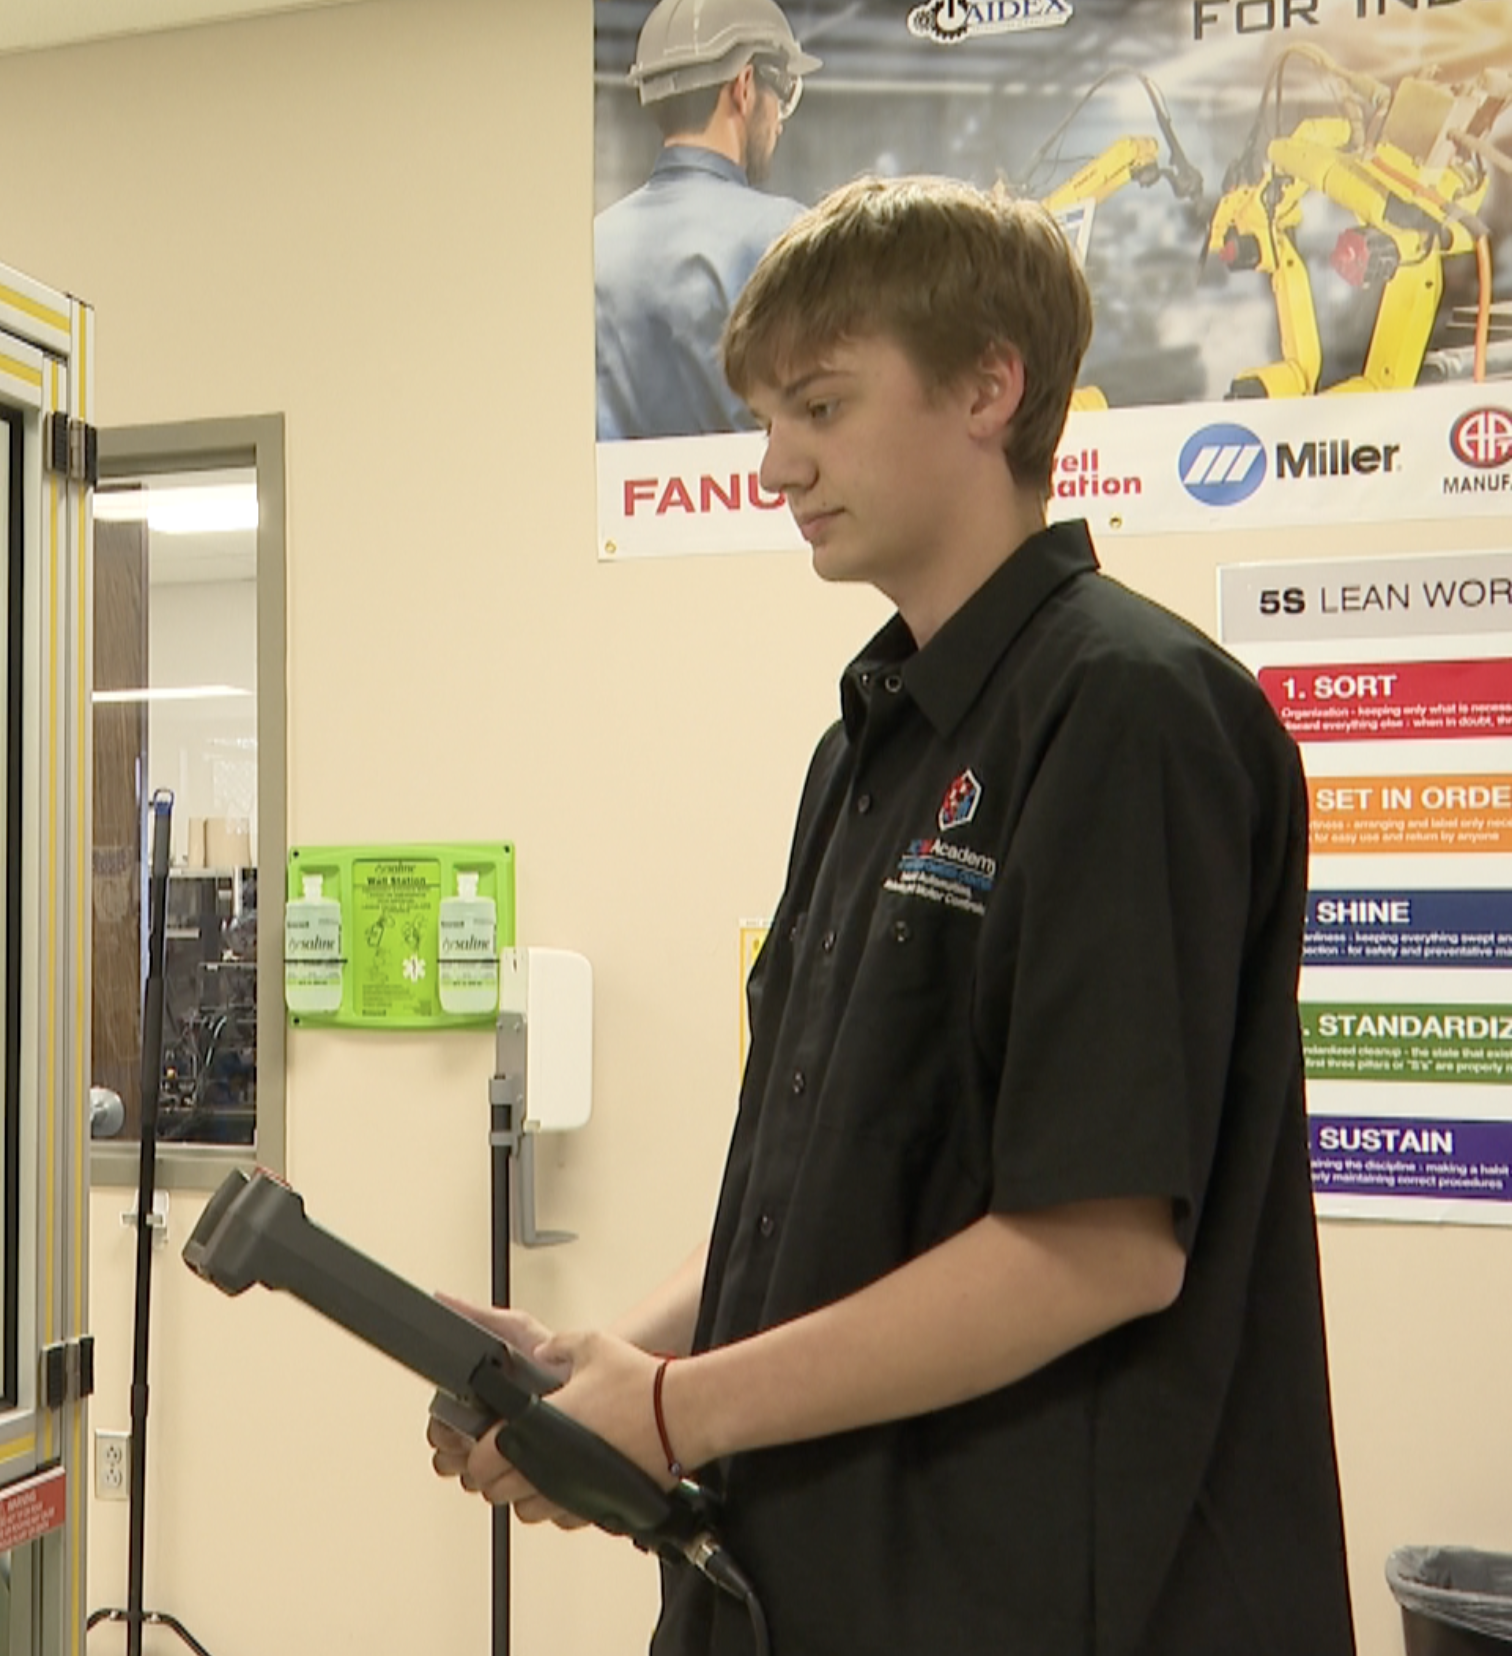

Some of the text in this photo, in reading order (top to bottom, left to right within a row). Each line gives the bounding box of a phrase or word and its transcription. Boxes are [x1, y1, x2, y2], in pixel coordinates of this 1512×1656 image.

[1194, 0, 1319, 40] FOR
[1053, 448, 1099, 473] ell
[1276, 440, 1401, 479] Miller
[624, 472, 786, 517] FANU
[1052, 474, 1142, 498] ation
[1443, 473, 1512, 495] MANUF
[1259, 578, 1512, 615] 5S LEAN WOR
[1283, 674, 1397, 700] 1. SORT
[1358, 705, 1402, 718] keeping
[1403, 704, 1426, 718] only
[1429, 703, 1456, 715] what
[1459, 702, 1468, 714] is
[1322, 719, 1378, 732] everything
[1380, 719, 1403, 729] else
[1412, 718, 1443, 729] when
[1445, 717, 1456, 727] in
[1315, 785, 1512, 811] SET IN ORDE
[1353, 819, 1405, 831] arranging
[1407, 818, 1429, 829] and
[1431, 817, 1458, 829] label
[1460, 817, 1485, 831] only
[1314, 831, 1500, 844] for easy use and return by anyone
[909, 837, 997, 880] Academy
[1316, 901, 1410, 924] SHINE
[1355, 932, 1398, 944] keeping
[1400, 932, 1459, 944] everything
[1461, 932, 1494, 945] swept
[1497, 933, 1512, 943] an
[1347, 945, 1363, 955] for
[1364, 945, 1398, 957] safety
[1400, 945, 1422, 955] and
[1424, 945, 1493, 958] preventative
[1318, 1014, 1512, 1040] STANDARDIZ
[1358, 1046, 1402, 1059] cleanup
[1410, 1047, 1429, 1058] the
[1432, 1047, 1460, 1058] state
[1462, 1047, 1485, 1059] that
[1327, 1058, 1355, 1070] three
[1357, 1059, 1389, 1071] pillars
[1392, 1061, 1404, 1070] or
[1435, 1061, 1454, 1072] are
[1456, 1061, 1503, 1074] properly
[1319, 1128, 1454, 1154] SUSTAIN
[1345, 1160, 1363, 1170] the
[1364, 1160, 1416, 1173] discipline
[1426, 1162, 1467, 1175] making
[1469, 1165, 1478, 1175] a
[1480, 1164, 1509, 1176] habit
[1332, 1173, 1395, 1187] maintaining
[1397, 1175, 1436, 1187] correct
[1439, 1176, 1503, 1190] procedures
